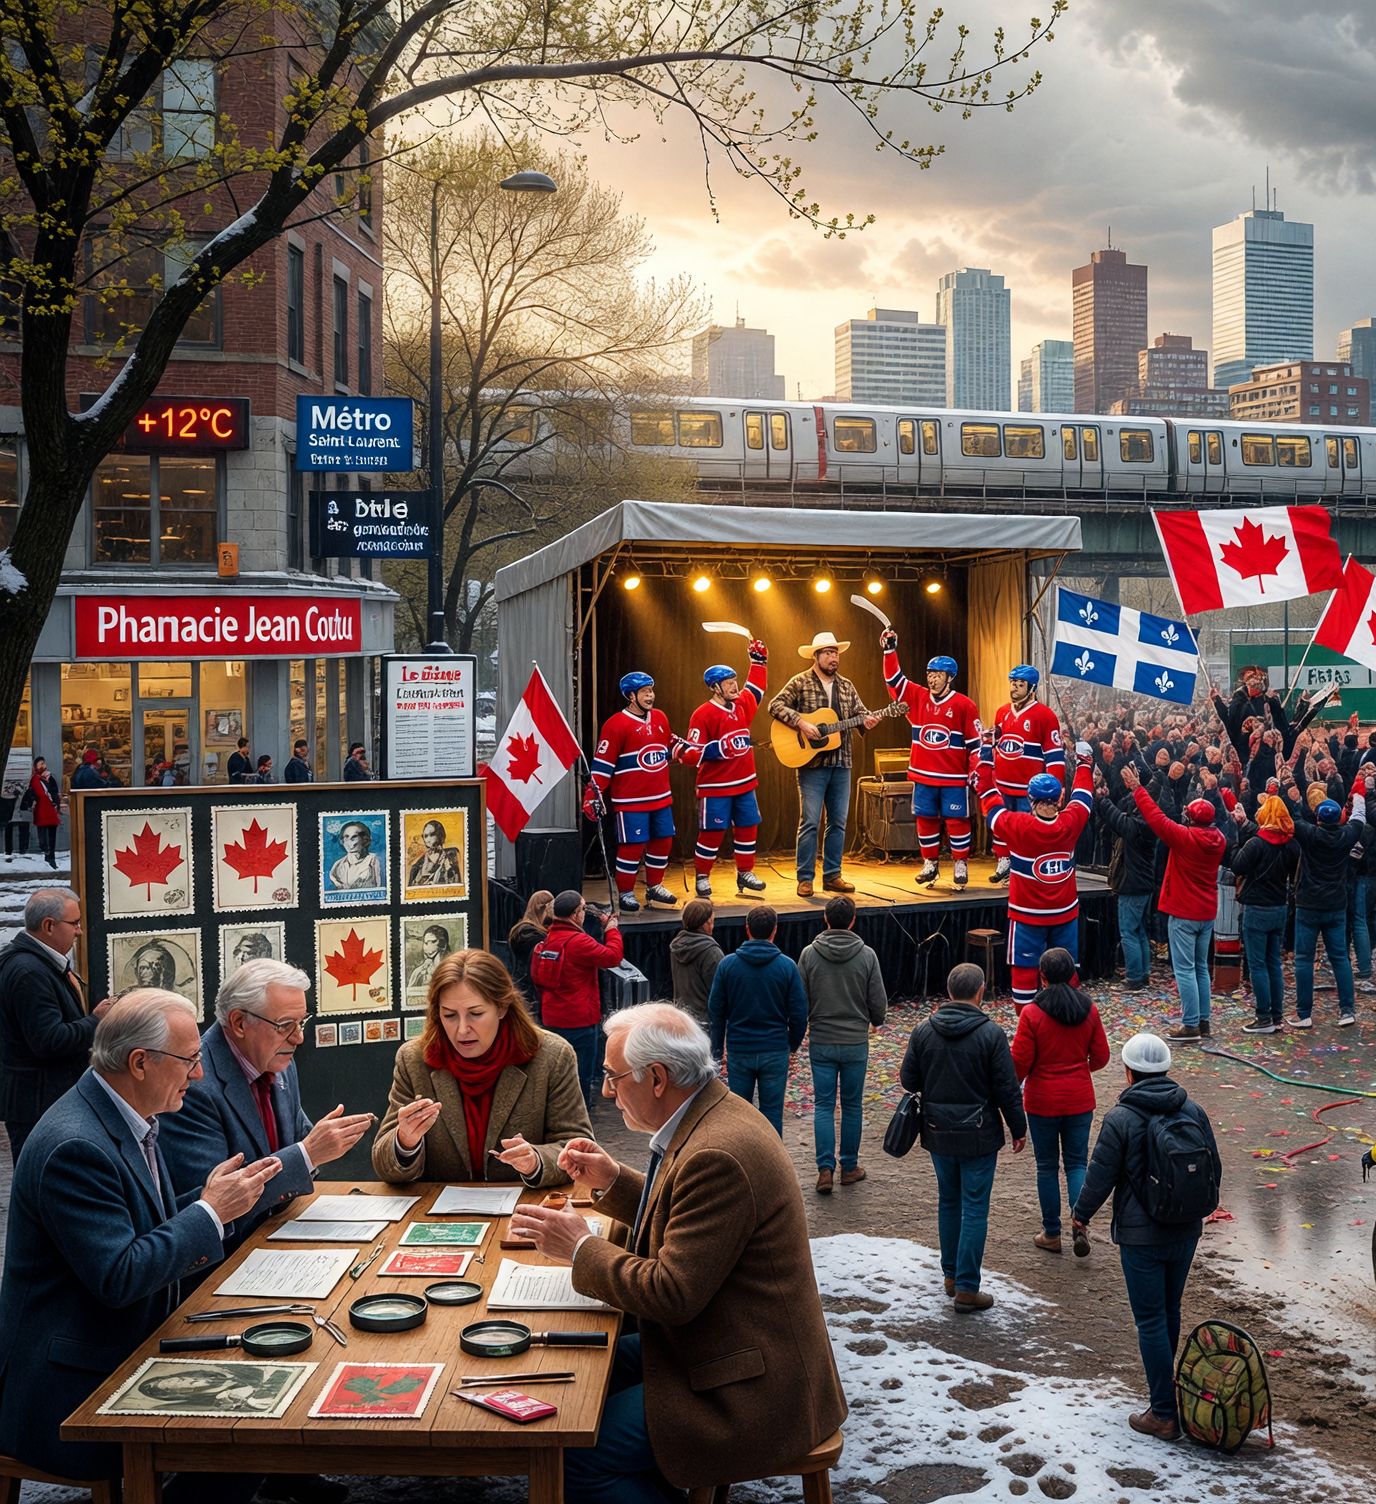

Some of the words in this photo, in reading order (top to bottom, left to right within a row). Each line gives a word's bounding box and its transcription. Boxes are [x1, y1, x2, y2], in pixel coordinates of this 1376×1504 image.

[137, 407, 233, 439] +12°C
[311, 405, 392, 431] Métro
[244, 605, 300, 642] Jean
